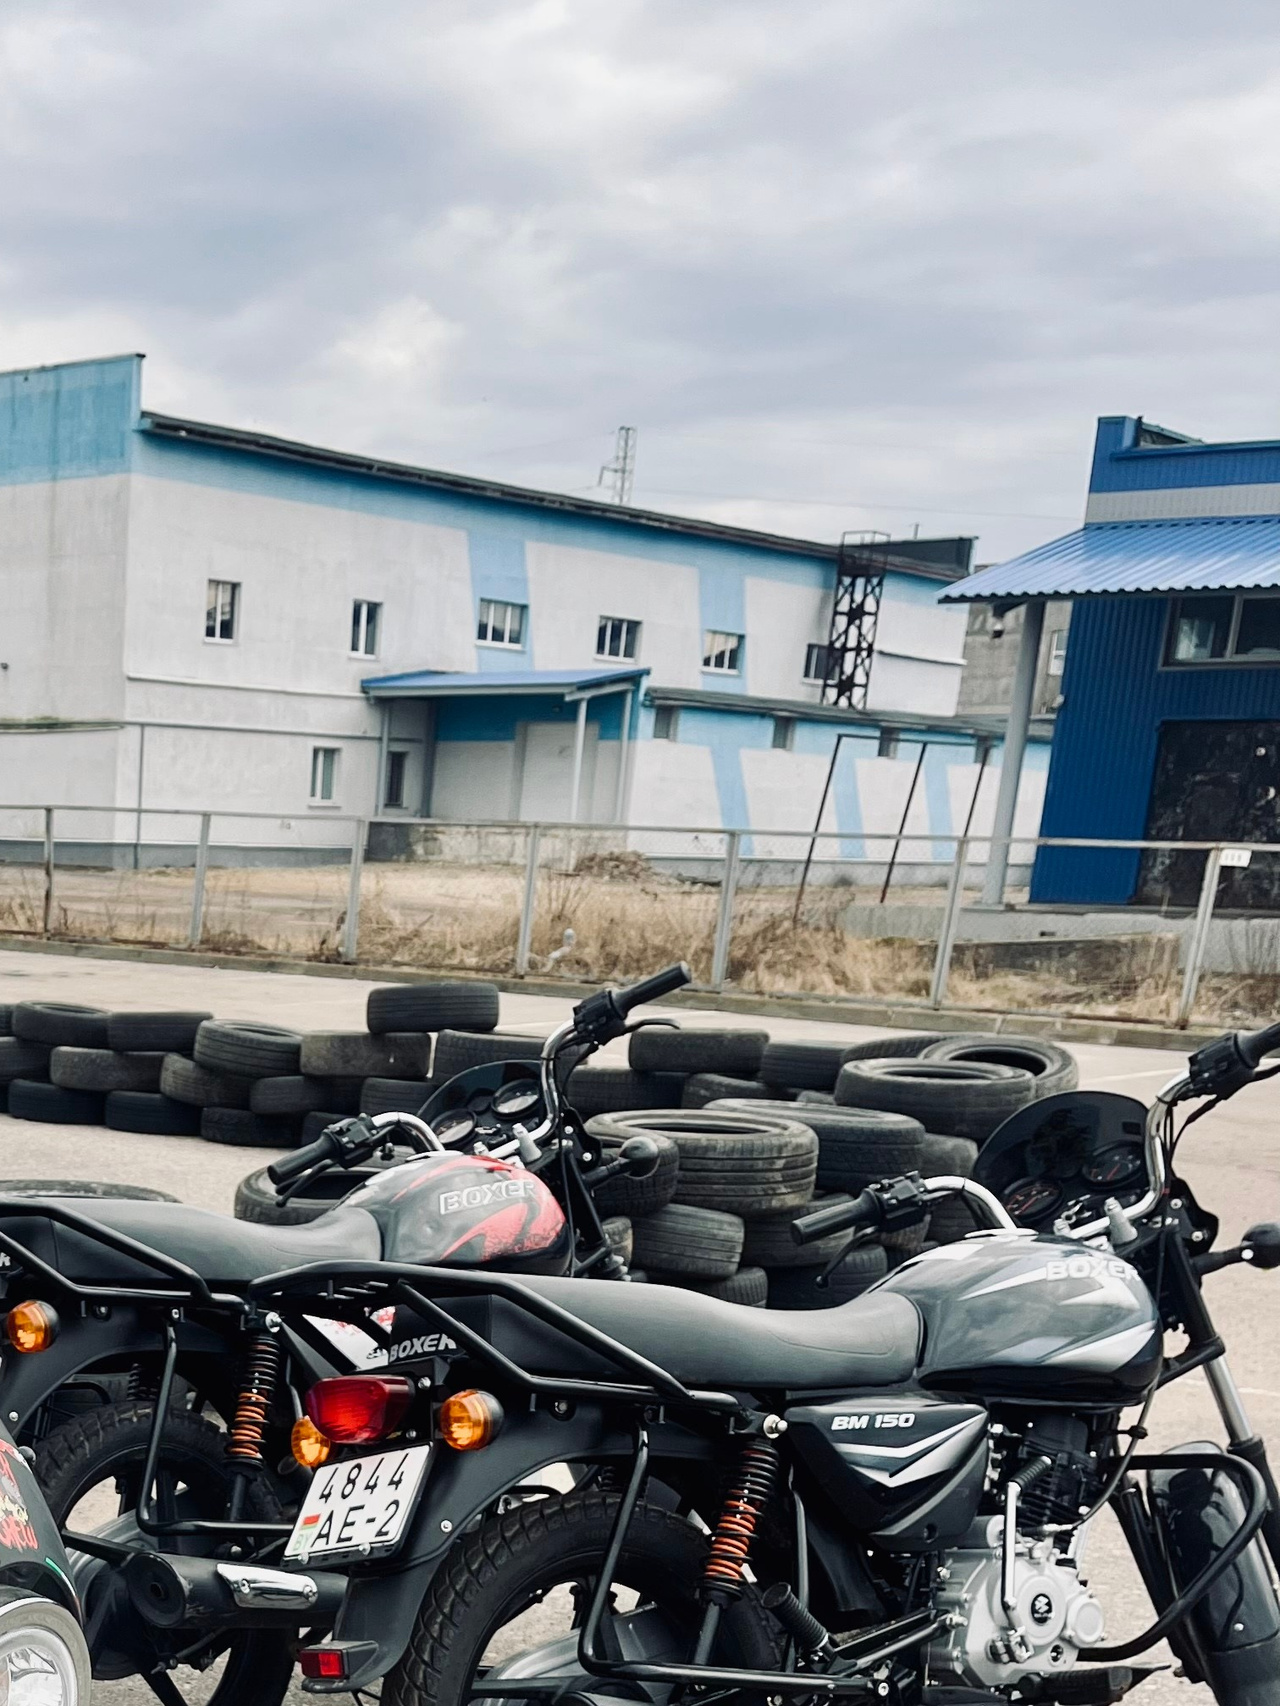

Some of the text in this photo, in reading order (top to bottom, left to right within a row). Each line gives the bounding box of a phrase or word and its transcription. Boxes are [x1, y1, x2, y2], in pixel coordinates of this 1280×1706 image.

[439, 1179, 537, 1215] BOXER
[1045, 1259, 1141, 1282] BOXER
[831, 1413, 915, 1431] BM 150
[318, 1452, 409, 1504] 4844
[310, 1499, 400, 1548] AE-2
